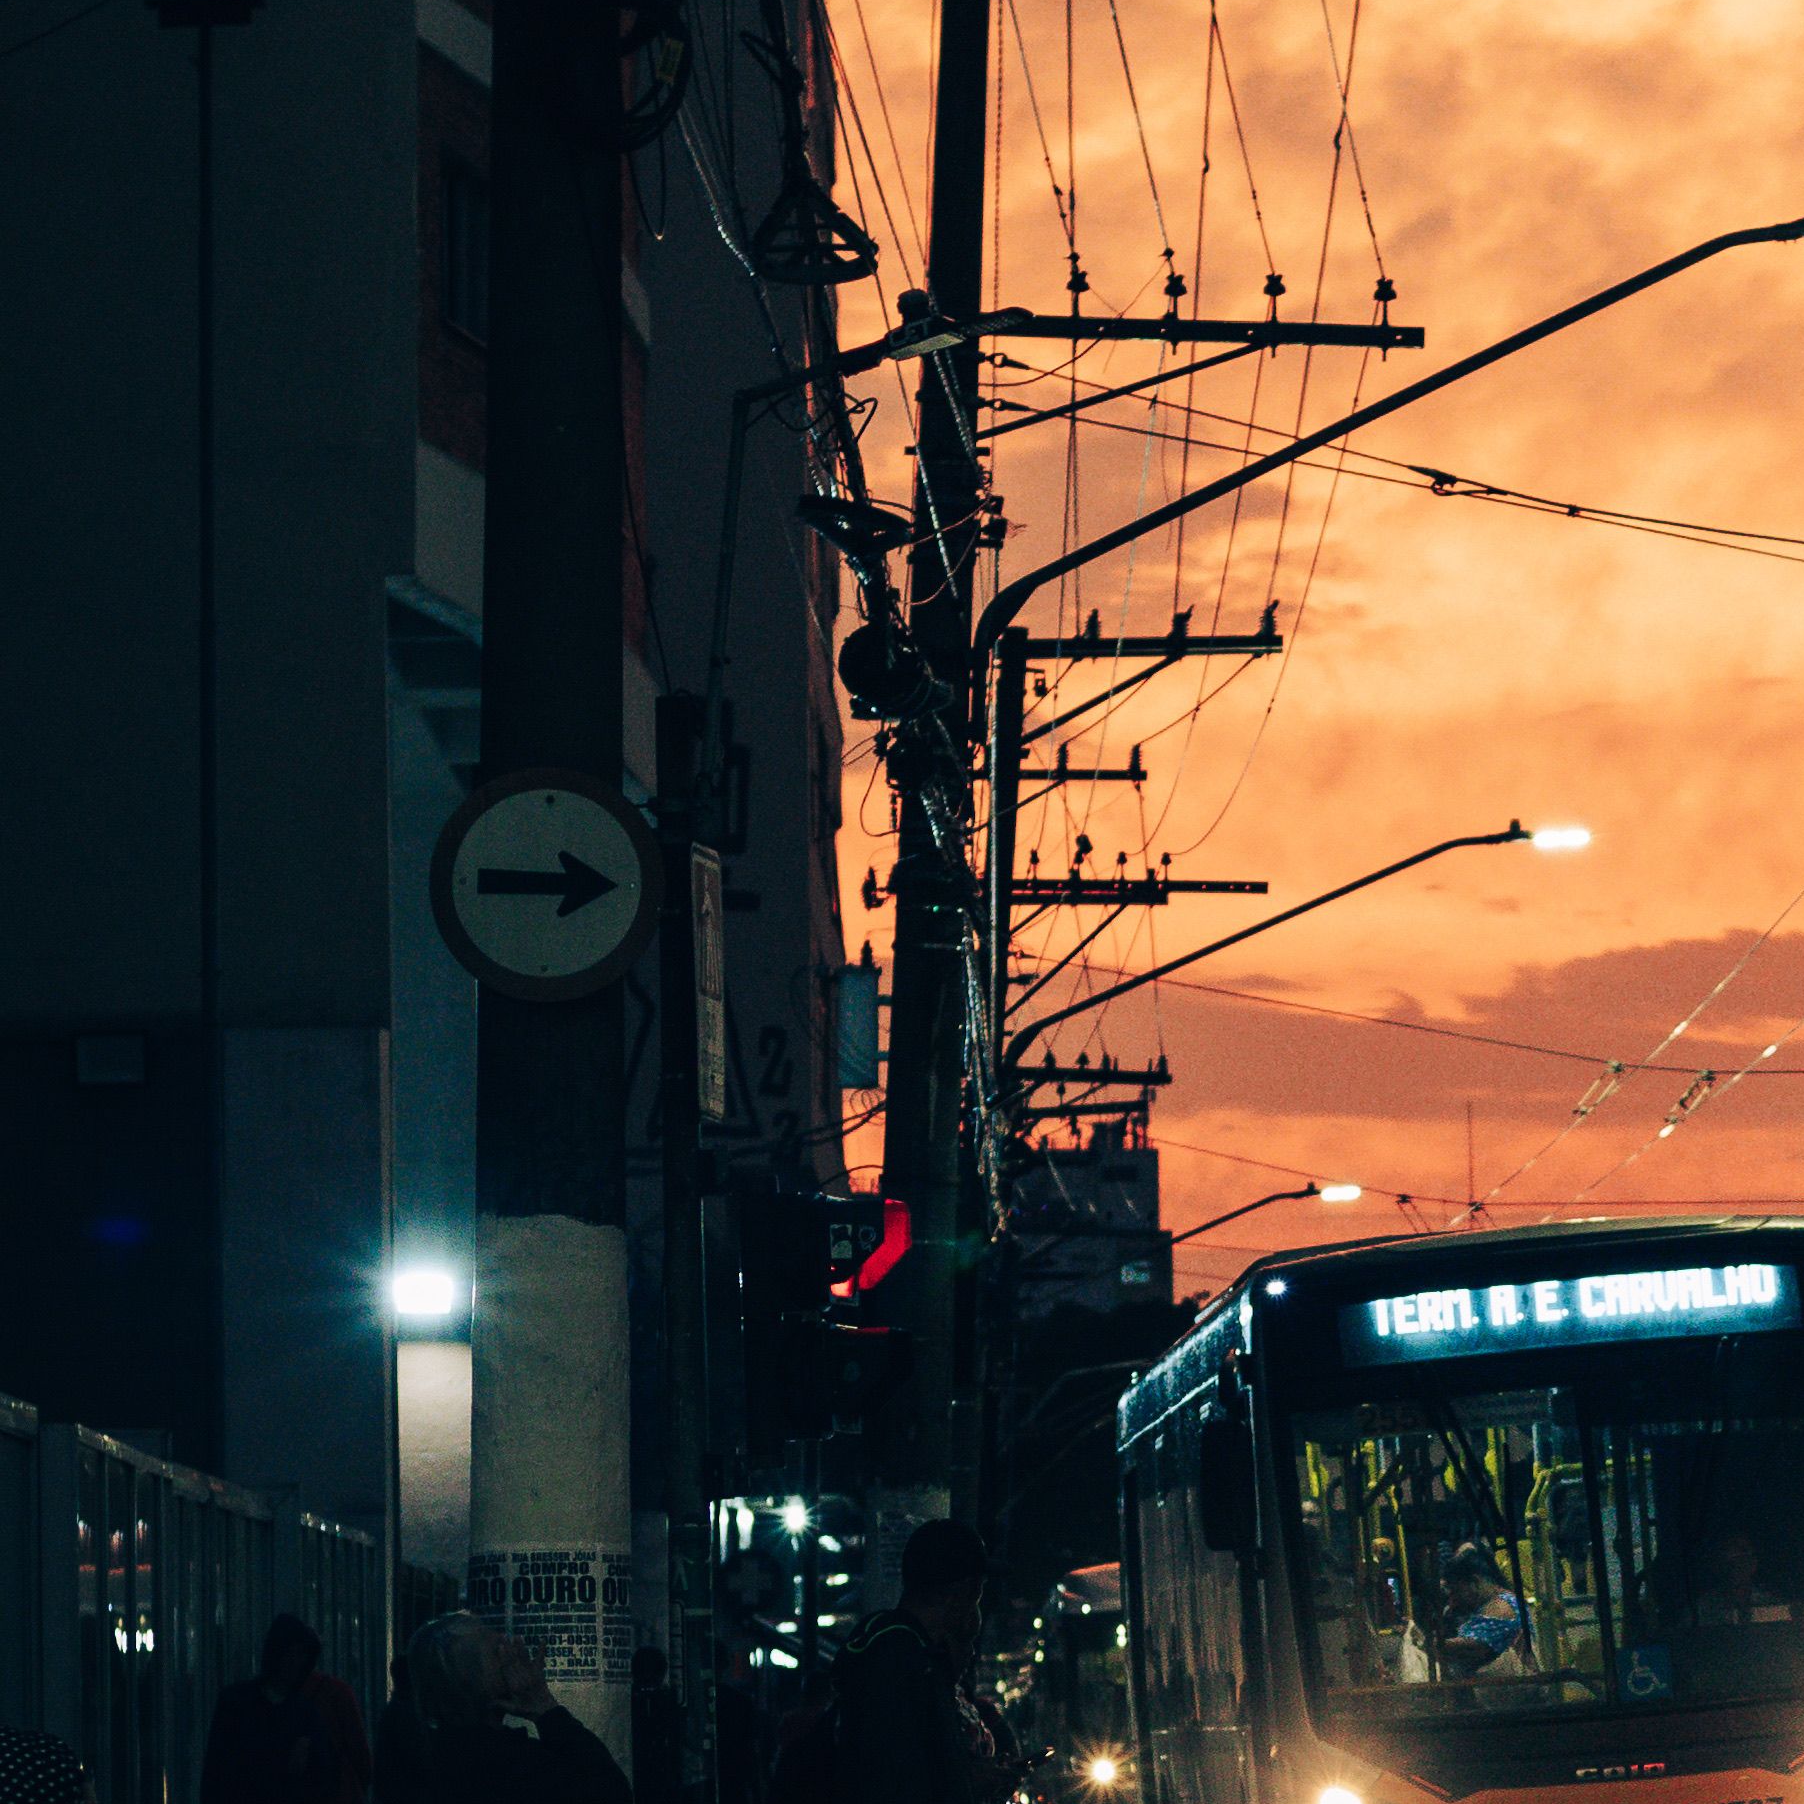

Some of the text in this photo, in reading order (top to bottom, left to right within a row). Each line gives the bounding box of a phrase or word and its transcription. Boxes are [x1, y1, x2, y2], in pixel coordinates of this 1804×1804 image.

[1371, 1264, 1778, 1336] TERM. A. E. CARVALHO
[519, 1561, 590, 1576] COMPRO
[512, 1575, 596, 1604] OURO
